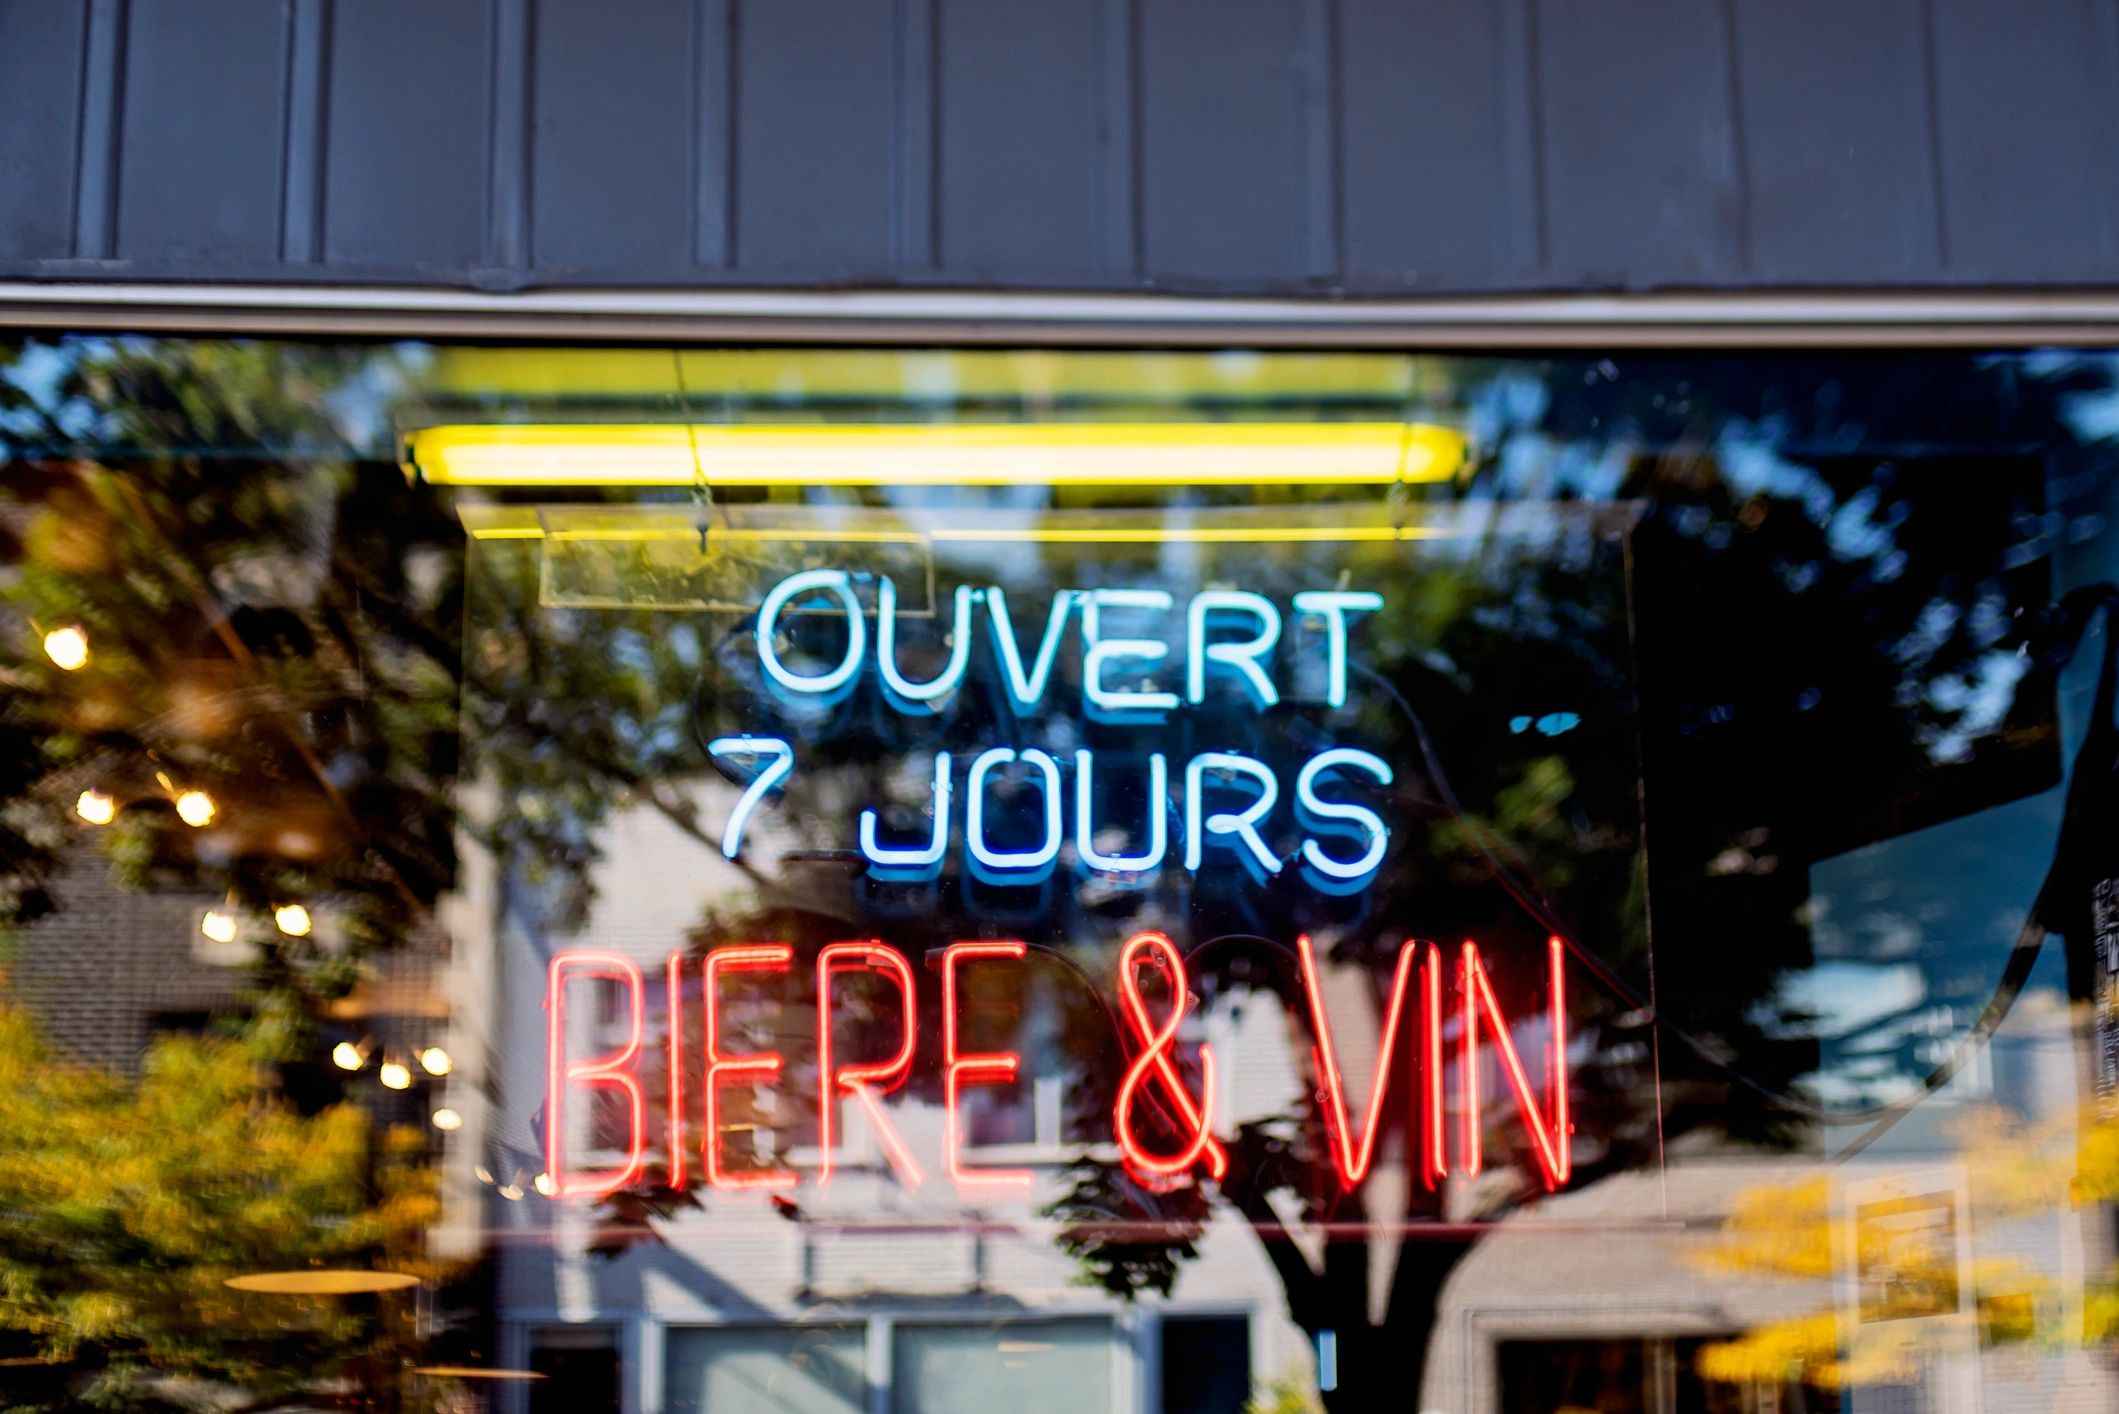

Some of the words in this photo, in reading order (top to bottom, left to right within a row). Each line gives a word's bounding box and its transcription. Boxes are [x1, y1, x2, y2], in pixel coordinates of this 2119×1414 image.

[756, 569, 1385, 710] OUVERT
[707, 736, 794, 859] 7
[859, 747, 1394, 880] JOURS
[546, 940, 1034, 1196] BIERE
[1115, 930, 1228, 1191] &
[1297, 934, 1572, 1188] VIN
